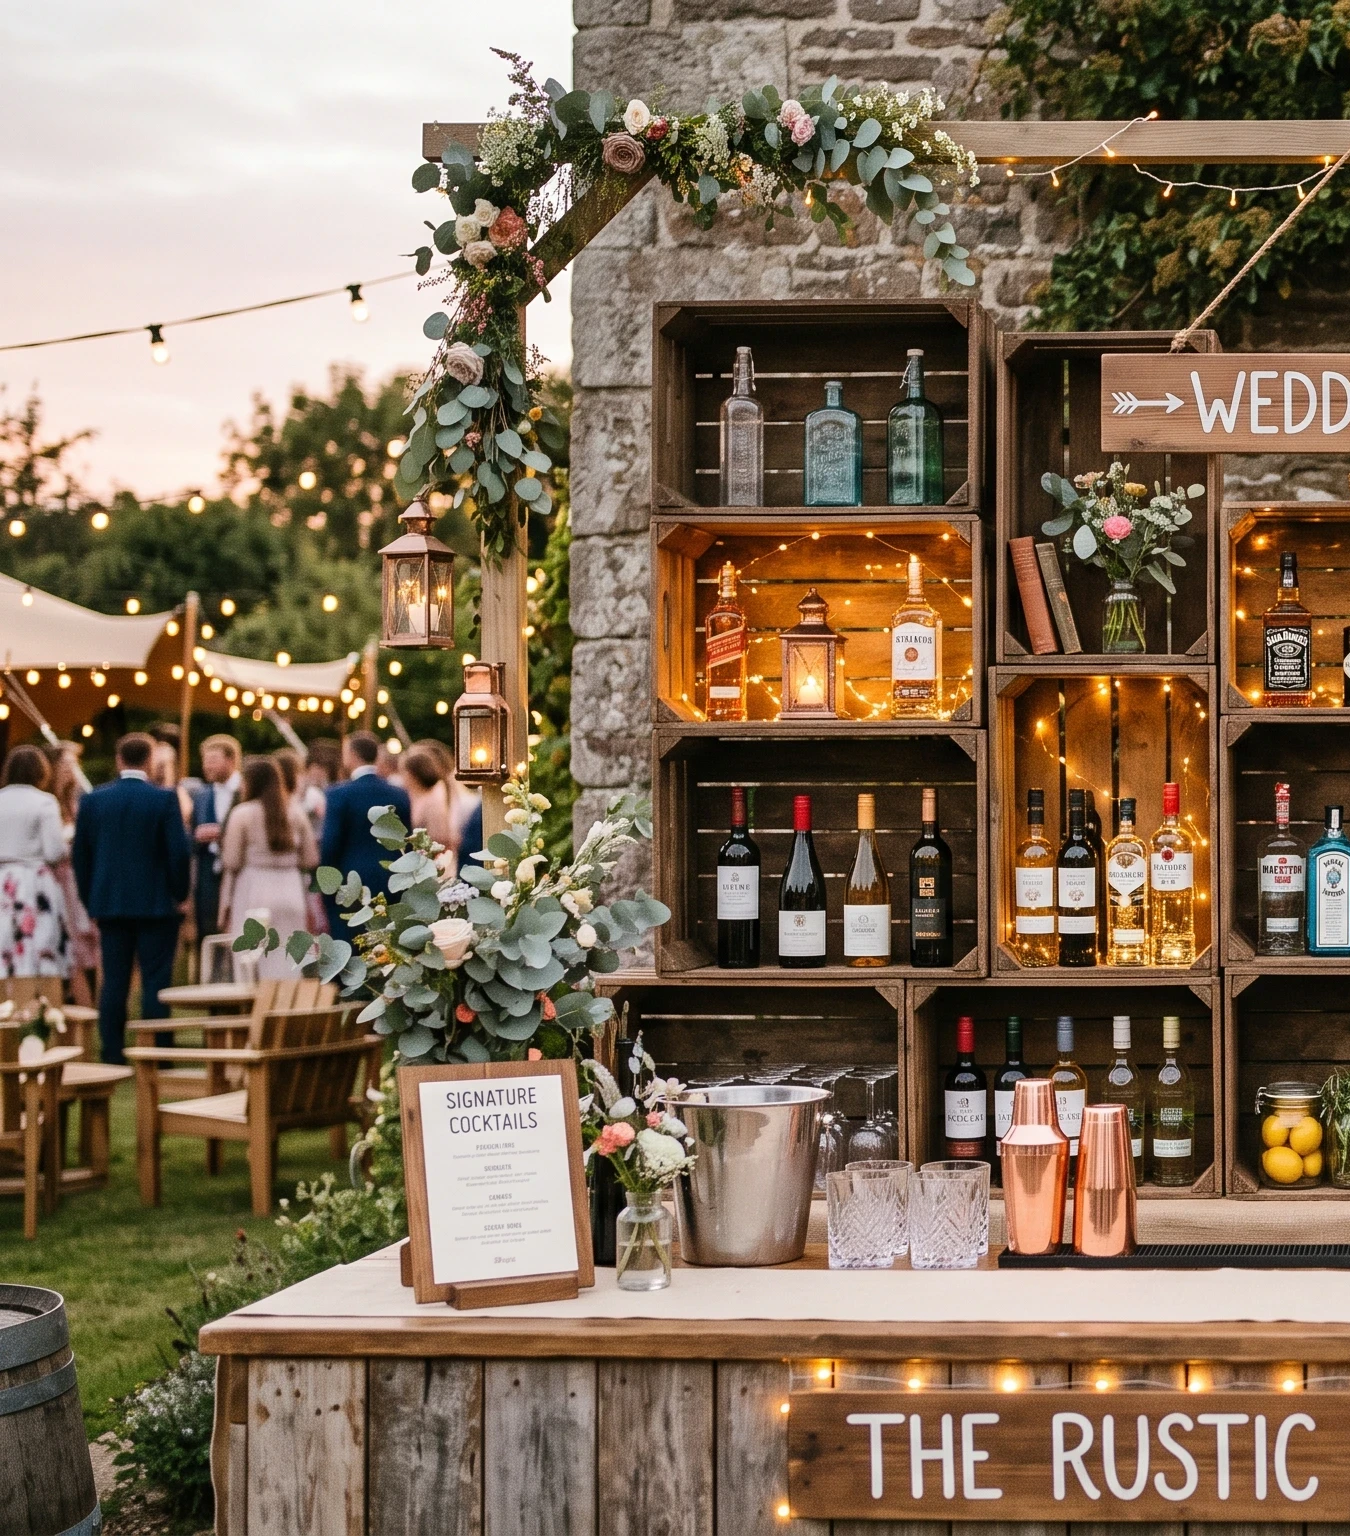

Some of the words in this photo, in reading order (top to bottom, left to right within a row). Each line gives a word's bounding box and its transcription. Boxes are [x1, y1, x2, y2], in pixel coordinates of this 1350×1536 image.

[446, 1087, 537, 1110] SIGNATURE
[449, 1111, 538, 1134] COCKTAILS
[846, 1412, 1002, 1501] THE
[1052, 1412, 1320, 1501] RUSTIC
